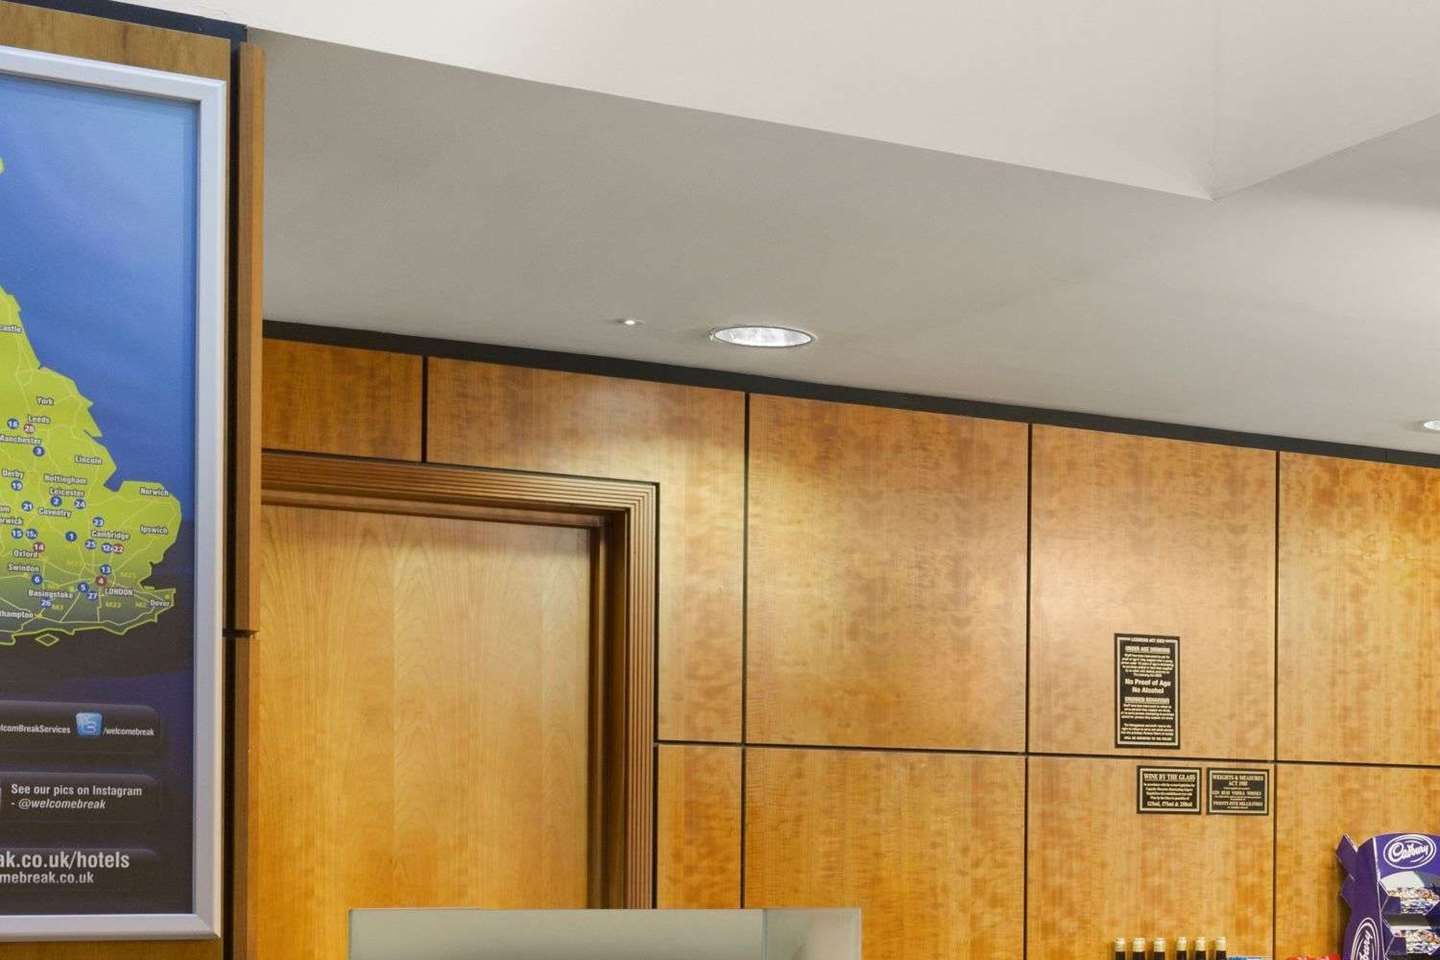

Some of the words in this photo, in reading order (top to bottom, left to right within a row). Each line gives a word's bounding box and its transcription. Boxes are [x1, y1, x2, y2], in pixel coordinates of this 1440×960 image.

[28, 415, 50, 424] Leeds
[75, 456, 102, 464] Lincoln
[44, 474, 87, 484] Nottingham
[12, 481, 22, 490] 19
[50, 488, 84, 496] Leicester
[140, 488, 169, 496] Norwich
[23, 502, 33, 511] 21
[91, 531, 129, 541] Cambridge
[14, 550, 38, 558] Oxford
[8, 563, 39, 572] Swindon
[28, 590, 73, 599] Basingstoke
[87, 591, 98, 600] 27
[105, 588, 134, 596] LONDON
[0, 724, 71, 734] lcomBreakServices
[11, 784, 31, 794] See
[33, 785, 50, 795] our
[53, 785, 74, 797] pics
[77, 787, 90, 796] on
[92, 785, 143, 798] Instagram
[18, 798, 106, 810] @welcomebreak
[1387, 841, 1430, 864] Cadbury
[0, 850, 131, 870] ak.co.uk/hotels
[0, 871, 95, 884] mebreak.co.uk
